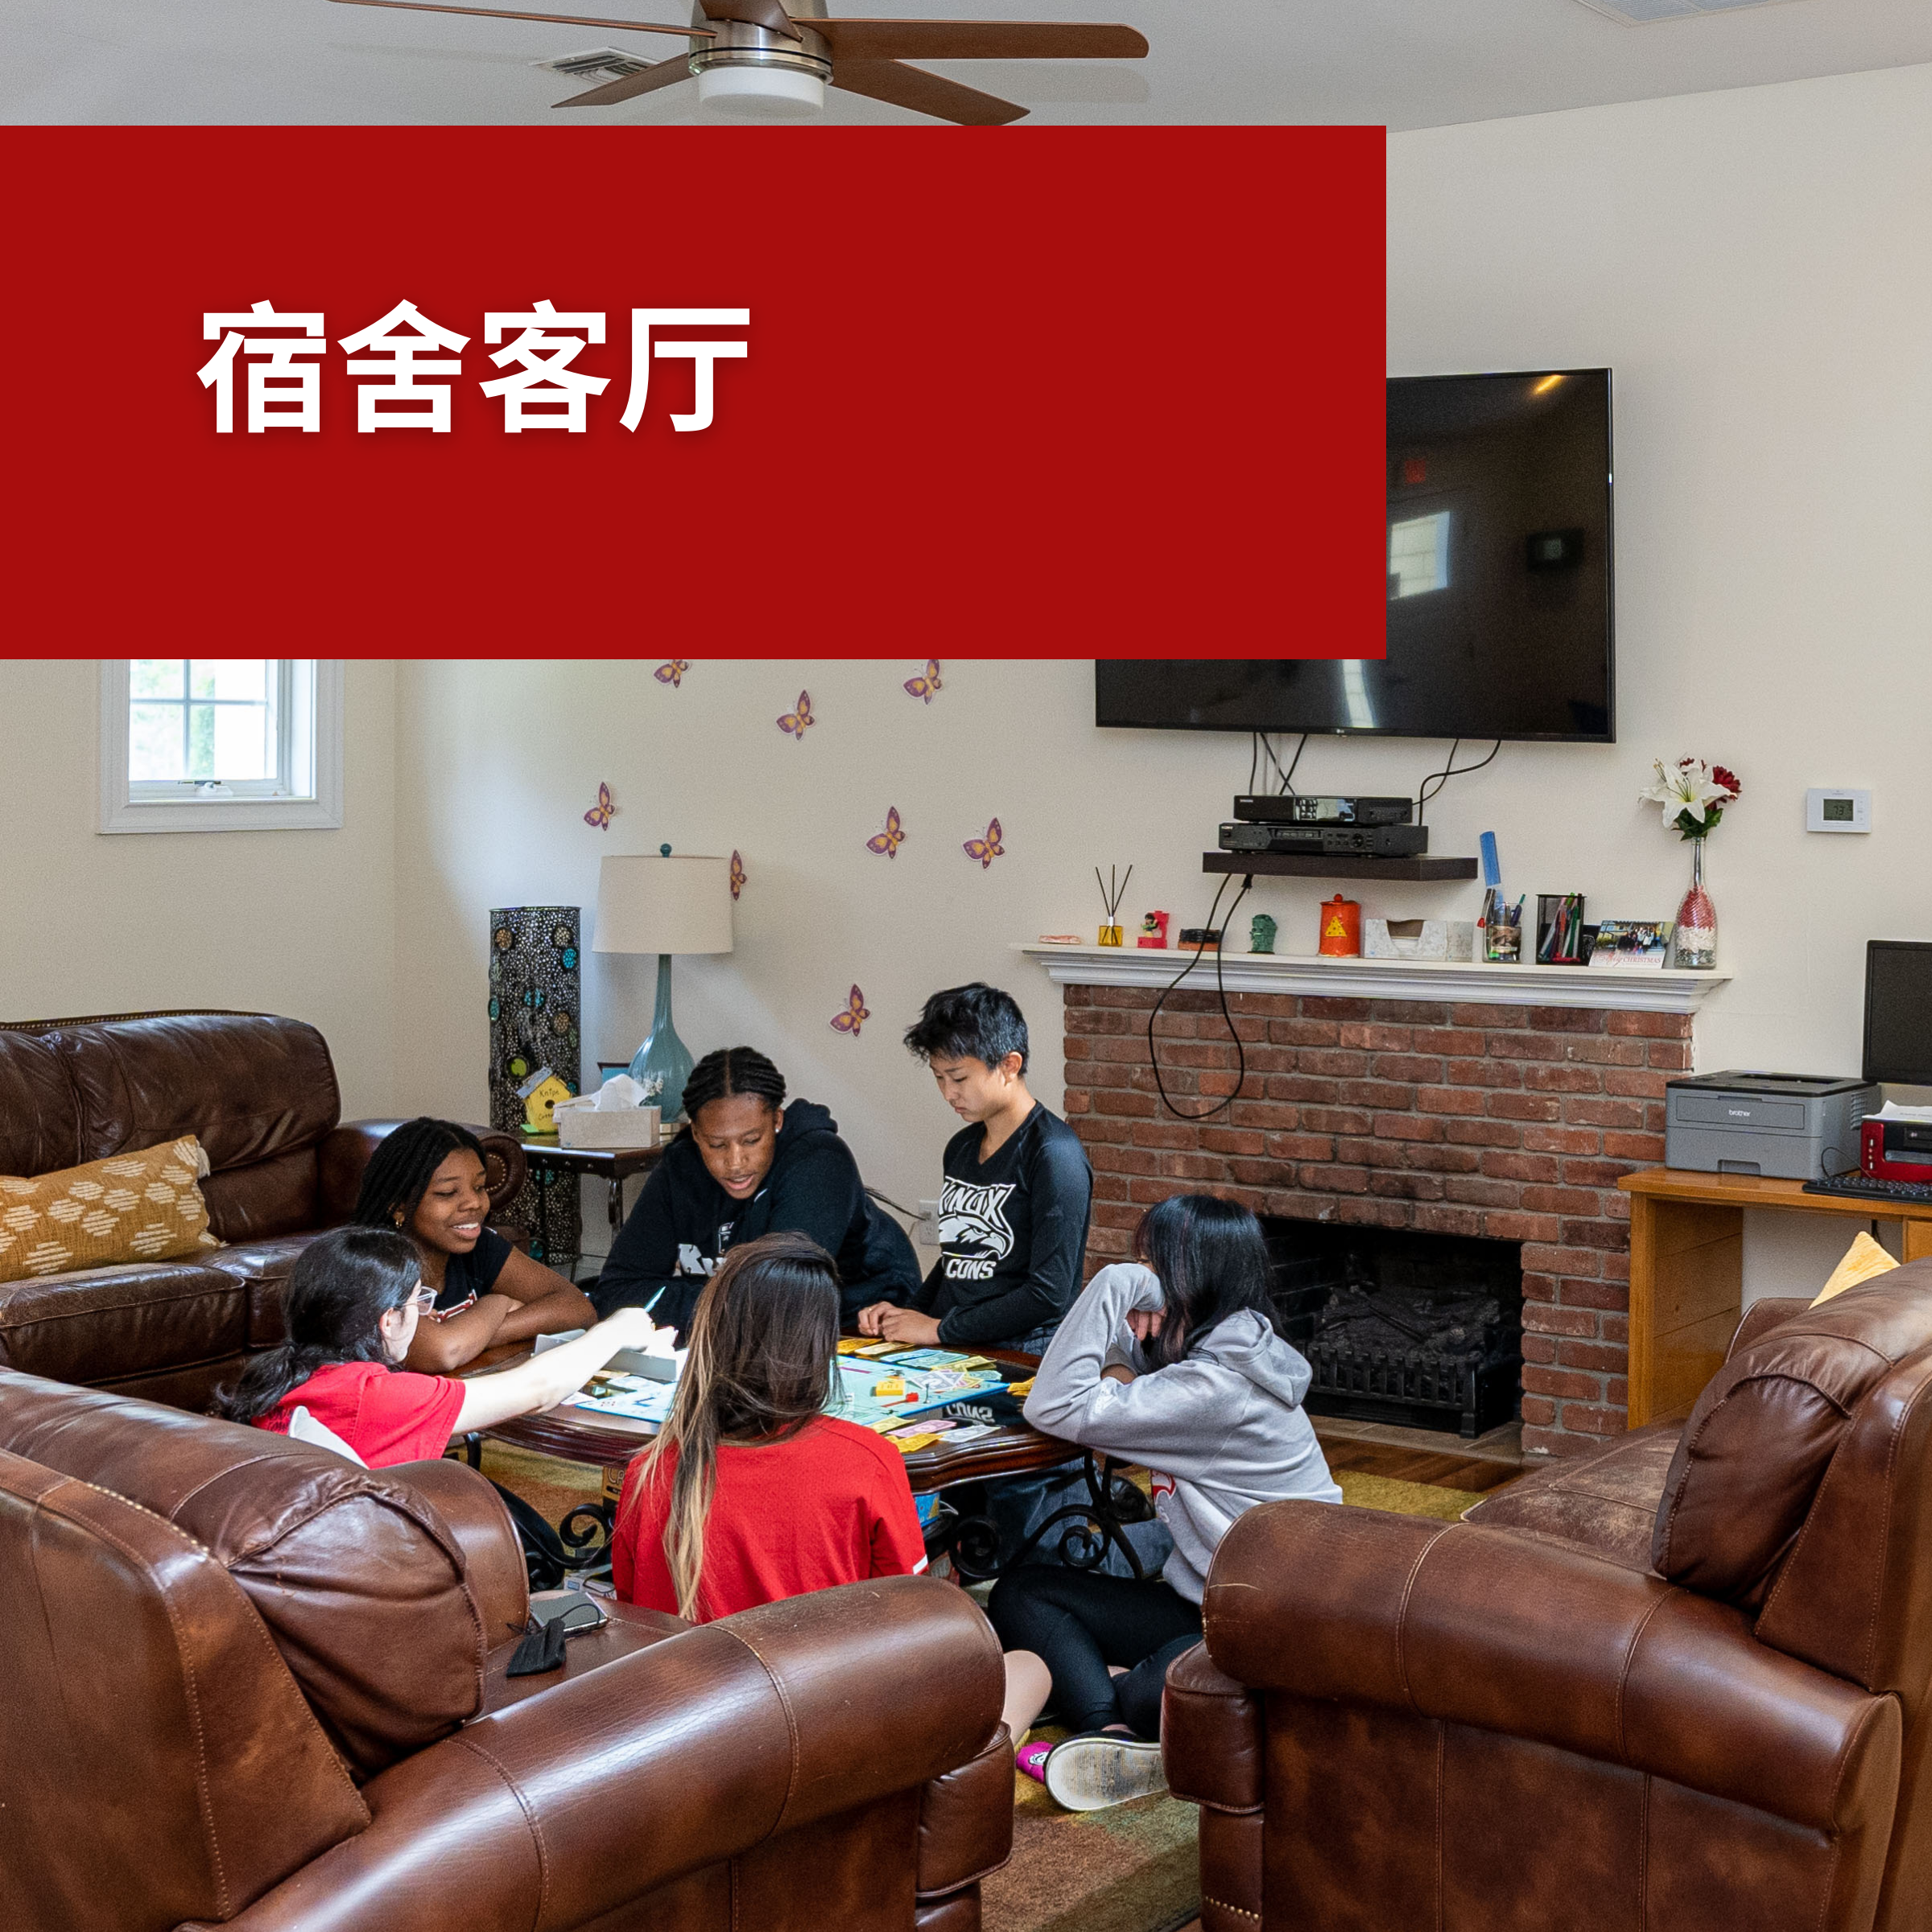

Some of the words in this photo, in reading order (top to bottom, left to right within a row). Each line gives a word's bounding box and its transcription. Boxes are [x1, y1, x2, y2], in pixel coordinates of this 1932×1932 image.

[1623, 955, 1661, 964] CHRISTMAS
[939, 1181, 1007, 1228] KNOX
[946, 1258, 997, 1280] CONS
